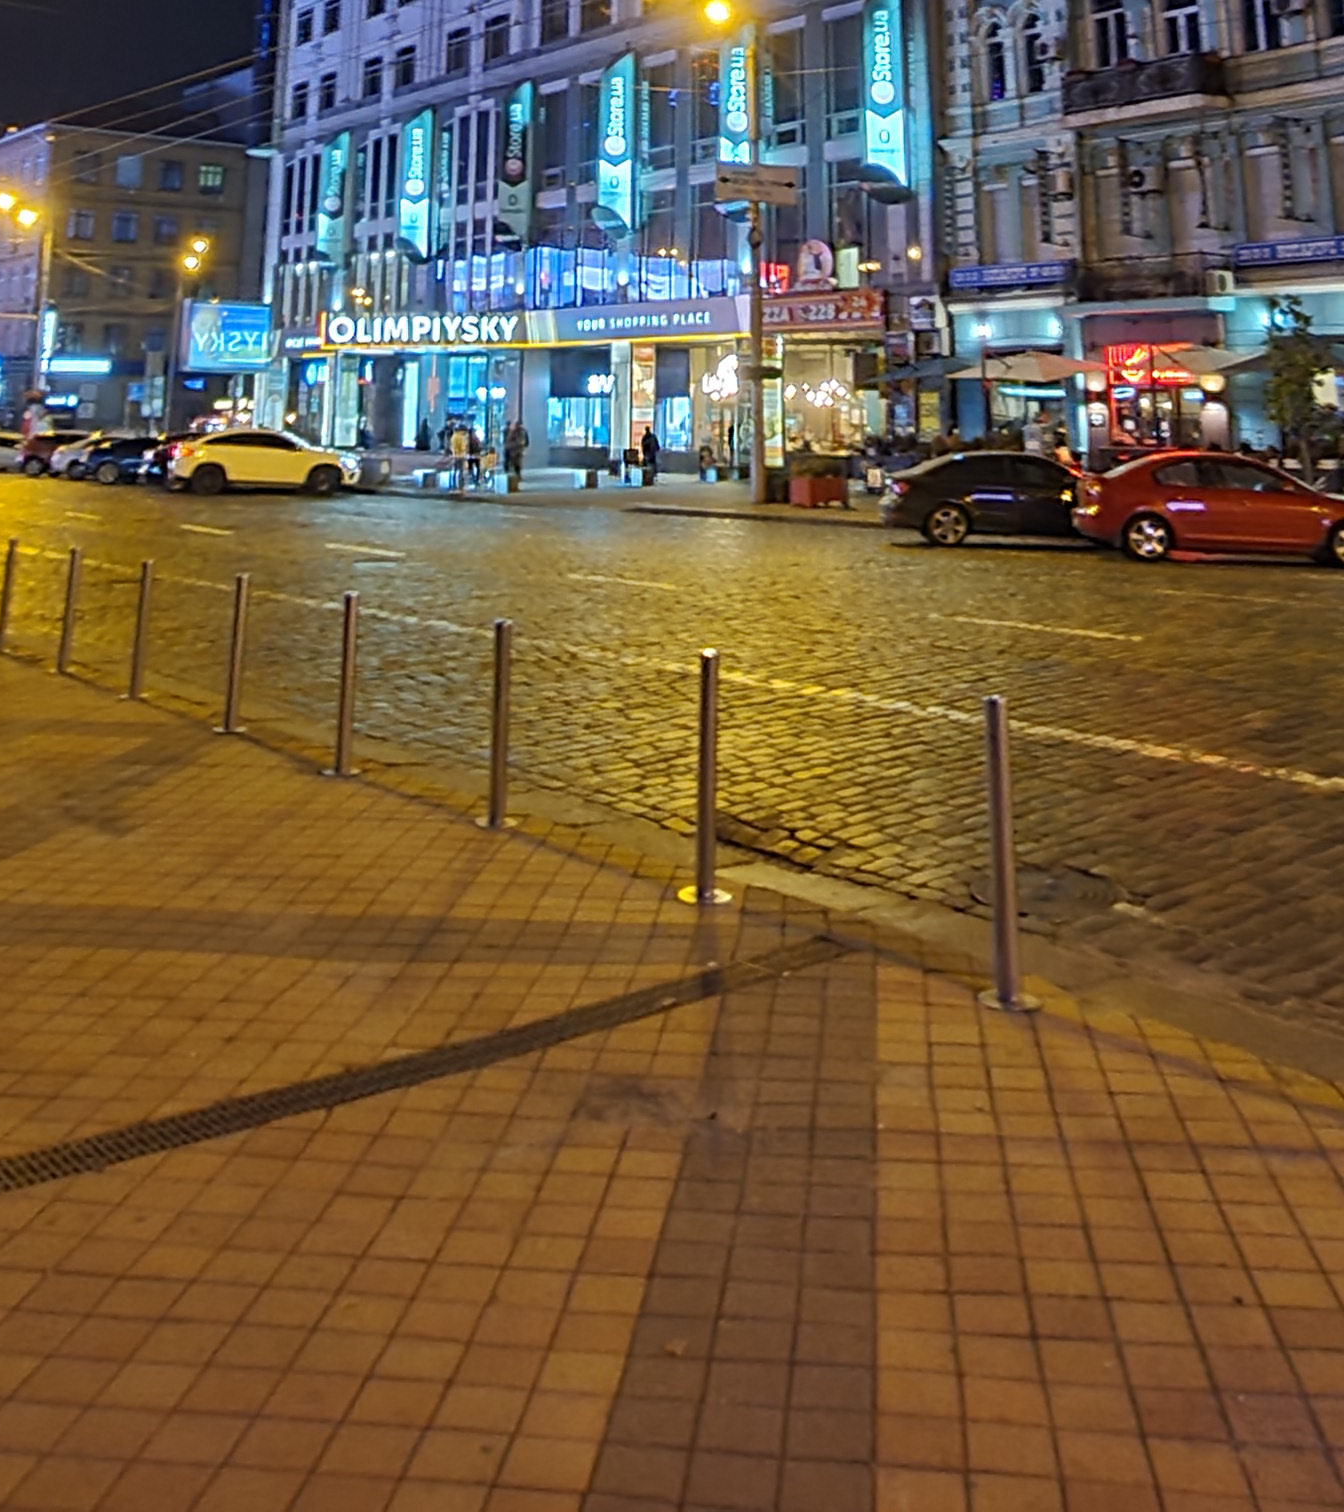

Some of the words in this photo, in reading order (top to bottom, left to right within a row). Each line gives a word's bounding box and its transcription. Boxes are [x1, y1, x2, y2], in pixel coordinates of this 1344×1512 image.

[328, 315, 519, 345] OLIMPIYSKY
[576, 317, 606, 332] YOUR
[609, 314, 668, 329] SHOPPING
[673, 311, 711, 326] PLACE
